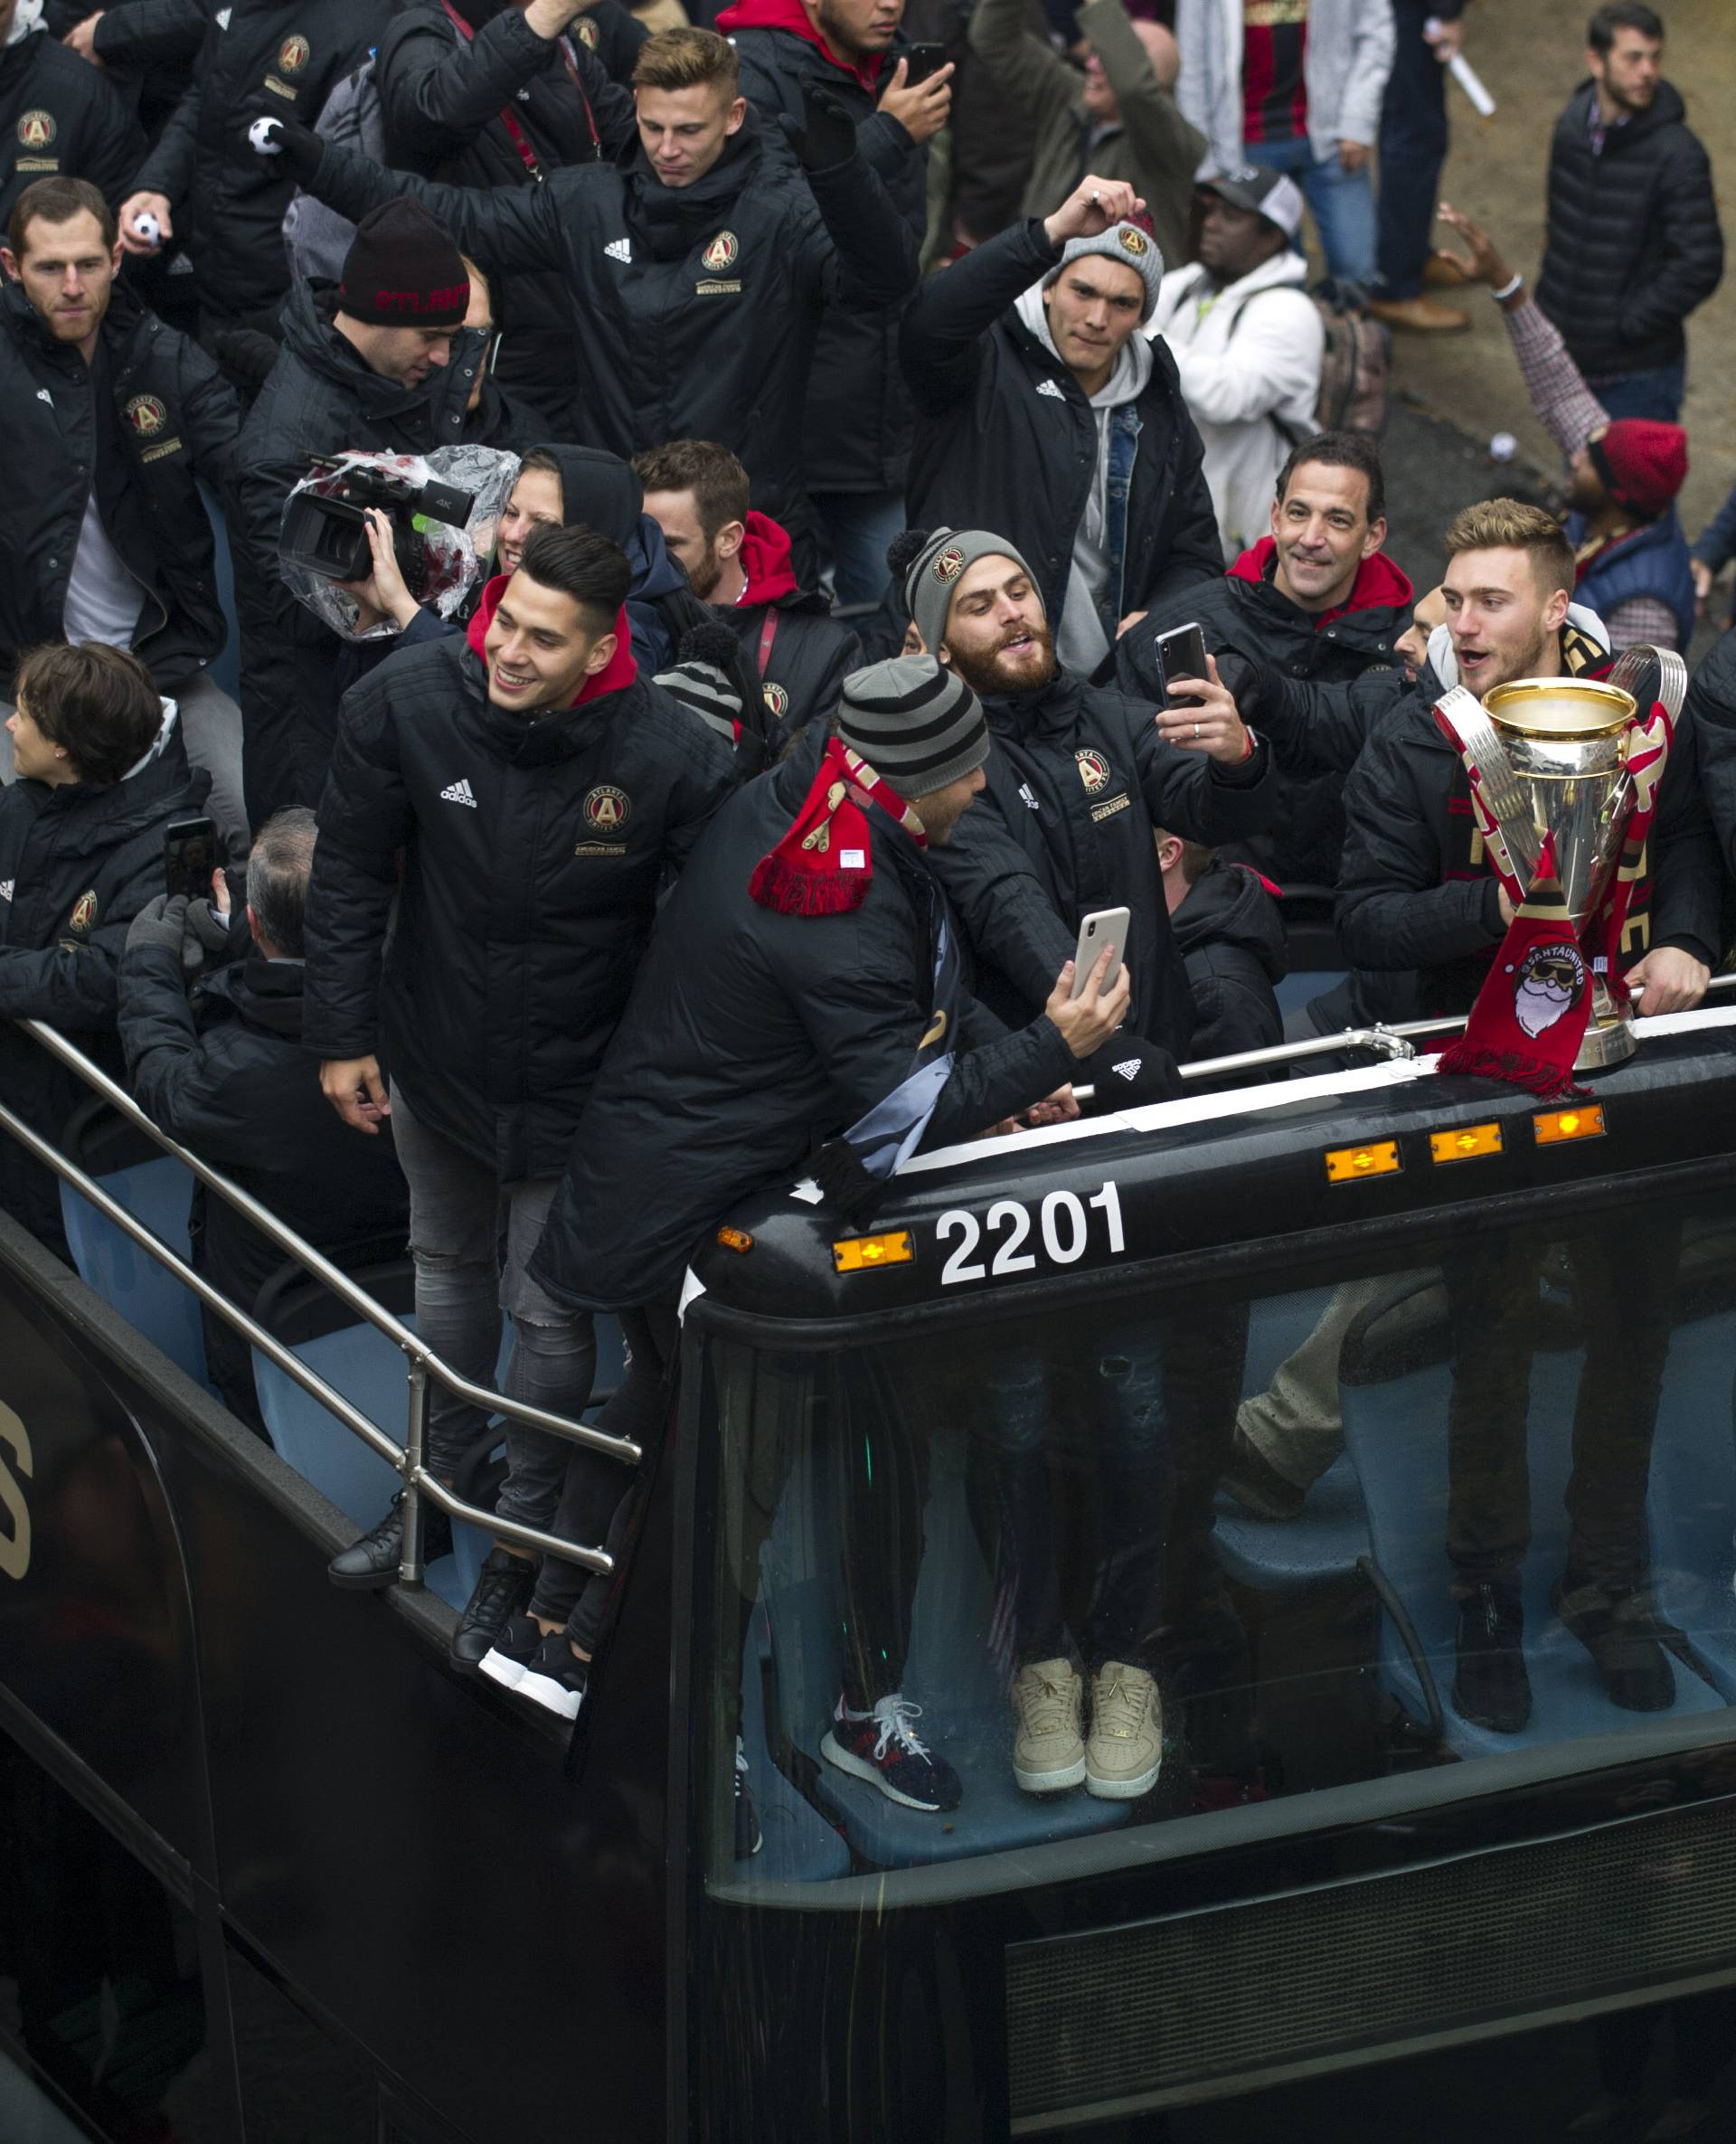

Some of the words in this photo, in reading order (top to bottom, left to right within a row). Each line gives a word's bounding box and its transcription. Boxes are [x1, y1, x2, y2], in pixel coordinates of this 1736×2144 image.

[284, 44, 299, 67] A
[29, 120, 46, 142] A
[710, 240, 728, 263] A
[1125, 231, 1140, 249] A
[137, 405, 158, 430] A
[942, 554, 960, 576] A
[1079, 760, 1101, 787] A
[440, 790, 477, 808] adidas
[596, 798, 618, 824] A
[75, 899, 88, 923] A
[937, 1181, 1125, 1285] 2201
